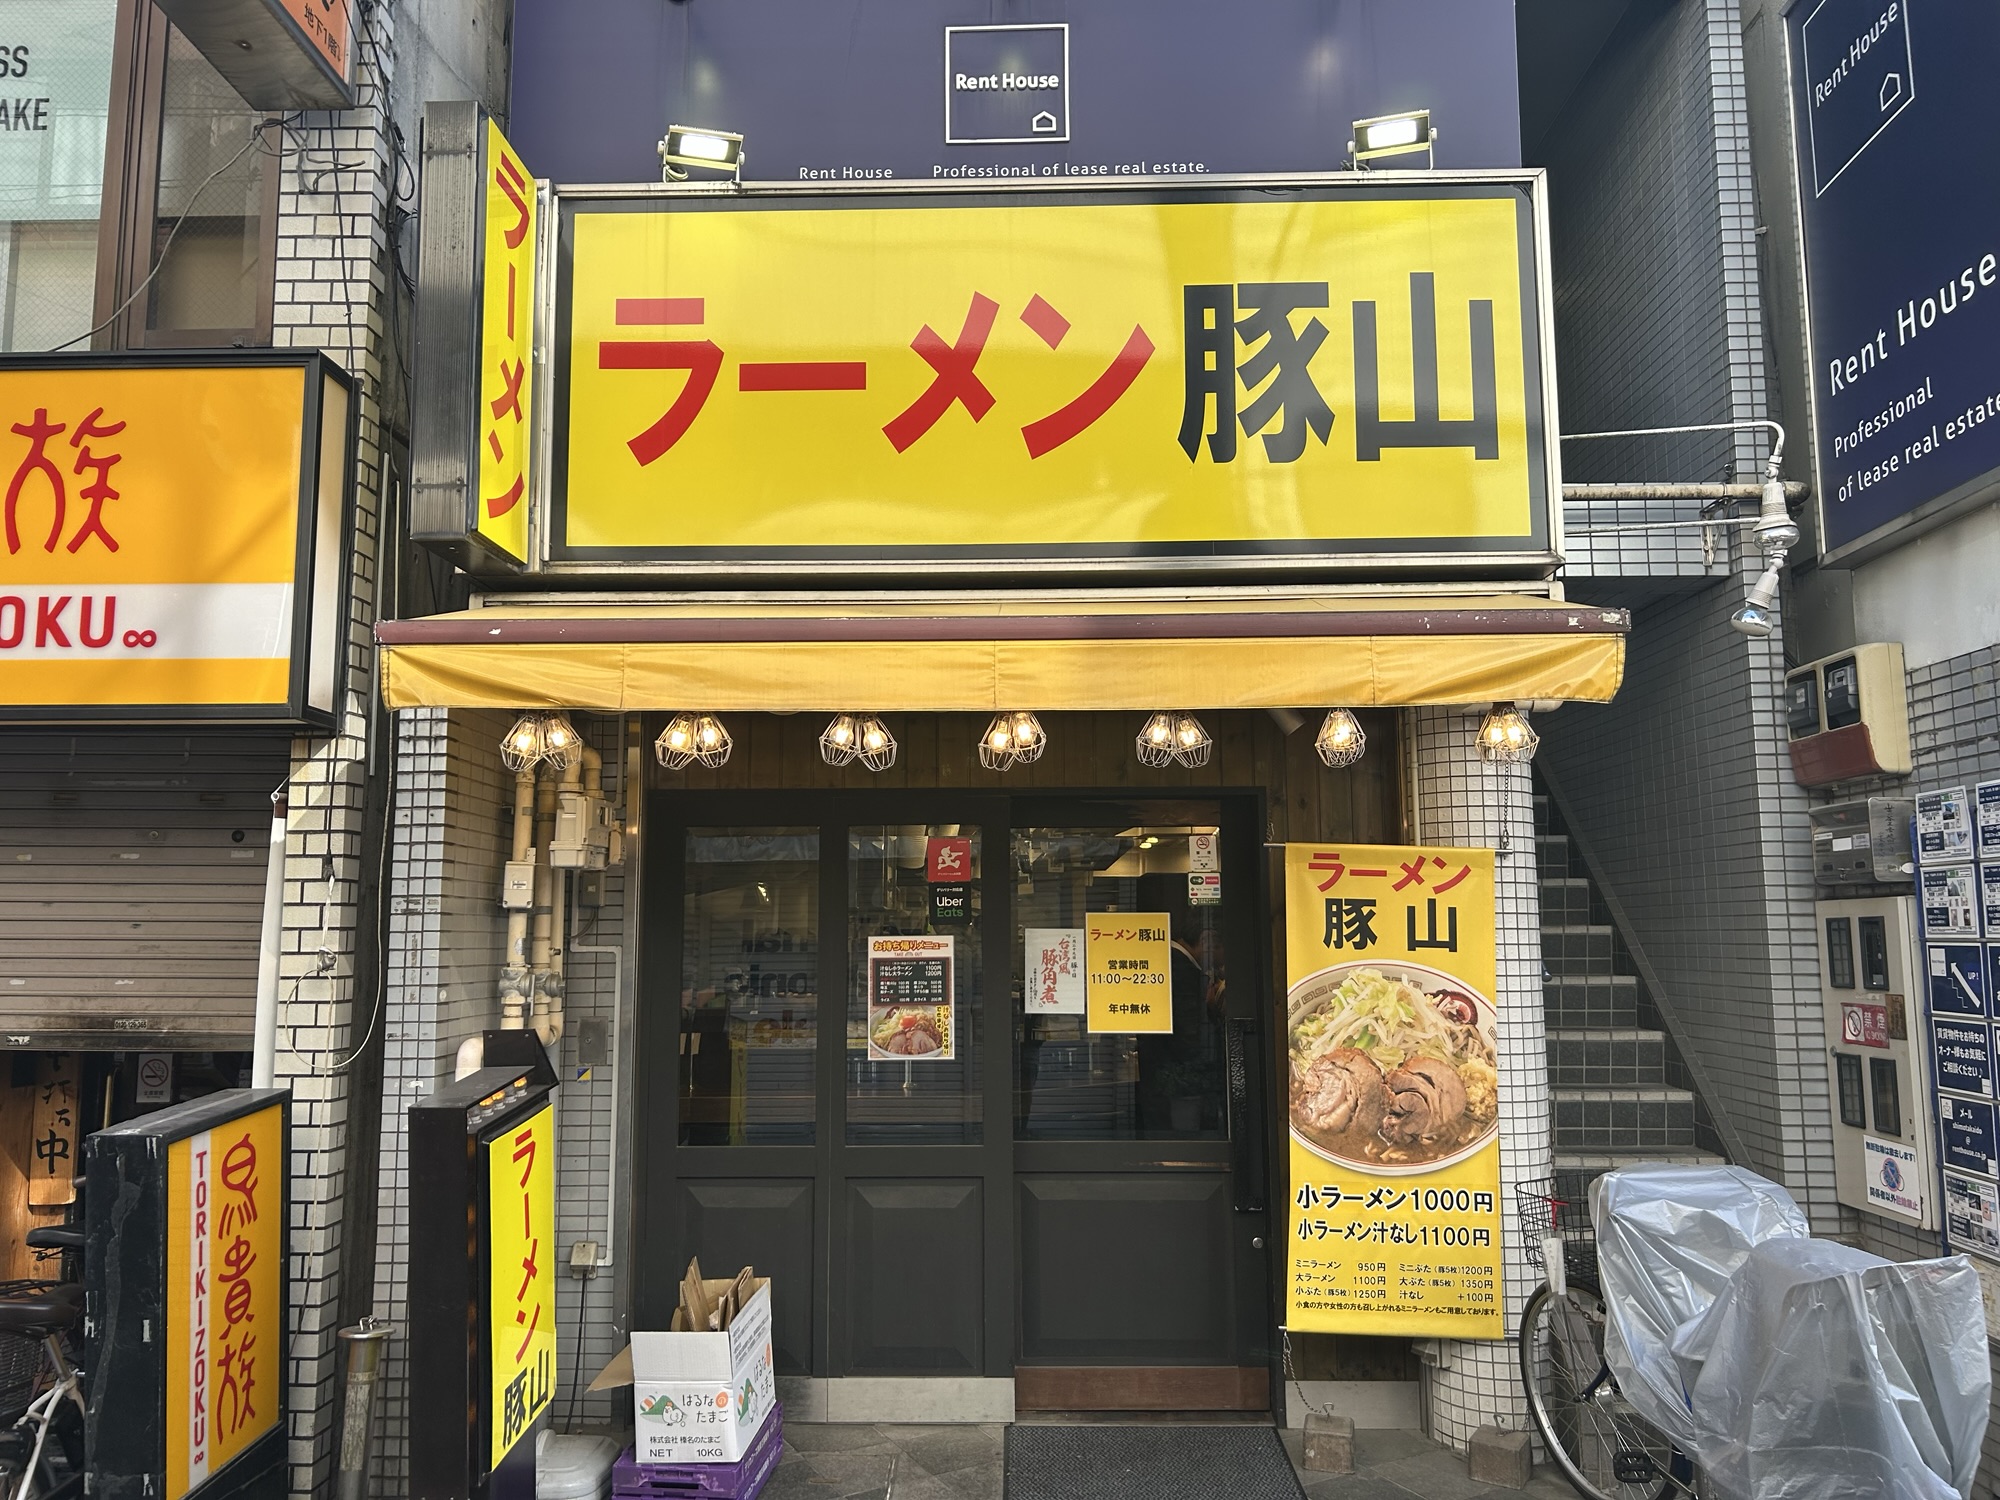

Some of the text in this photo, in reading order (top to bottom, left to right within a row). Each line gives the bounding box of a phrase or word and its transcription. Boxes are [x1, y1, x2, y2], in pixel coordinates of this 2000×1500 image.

[1816, 1, 1898, 107] Rent House
[956, 72, 1060, 91] Rent House
[800, 166, 893, 180] Rent House
[933, 160, 1211, 178] Professional of lease real estate.
[1830, 252, 1998, 396] Rent House
[487, 151, 528, 518] ラーメン
[599, 272, 1500, 466] ラーメン豚山
[1834, 377, 1934, 458] Professional
[1839, 476, 1856, 502] of
[1858, 454, 1900, 490] lease
[1905, 426, 1940, 464] real
[5, 407, 126, 555] 族
[1308, 853, 1471, 894] ラーメン
[936, 896, 964, 907] Uber
[937, 908, 964, 918] Eats
[1323, 898, 1458, 953] 豚山
[1090, 928, 1166, 942] ラーメン豚山
[873, 940, 948, 951] お持ち帰りメニュー
[1108, 959, 1149, 971] 営業時間
[1967, 972, 1979, 980] UP!
[1108, 1003, 1151, 1015] 年中無休
[512, 1129, 540, 1364] ラーメン
[1295, 1259, 1386, 1272] ミニラーメン 950円
[1461, 1266, 1493, 1275] 1200円
[1295, 1273, 1386, 1285] 大ラーメン 1100円
[1460, 1279, 1493, 1289] 1350円
[1353, 1289, 1386, 1299] 1250円
[1399, 1290, 1424, 1299] 汁なし
[502, 1348, 550, 1448] 豚山
[682, 1392, 729, 1408] はるなの
[696, 1411, 729, 1423] たまご
[650, 1436, 678, 1444] 株式会社
[650, 1449, 723, 1457] NET 10KG
